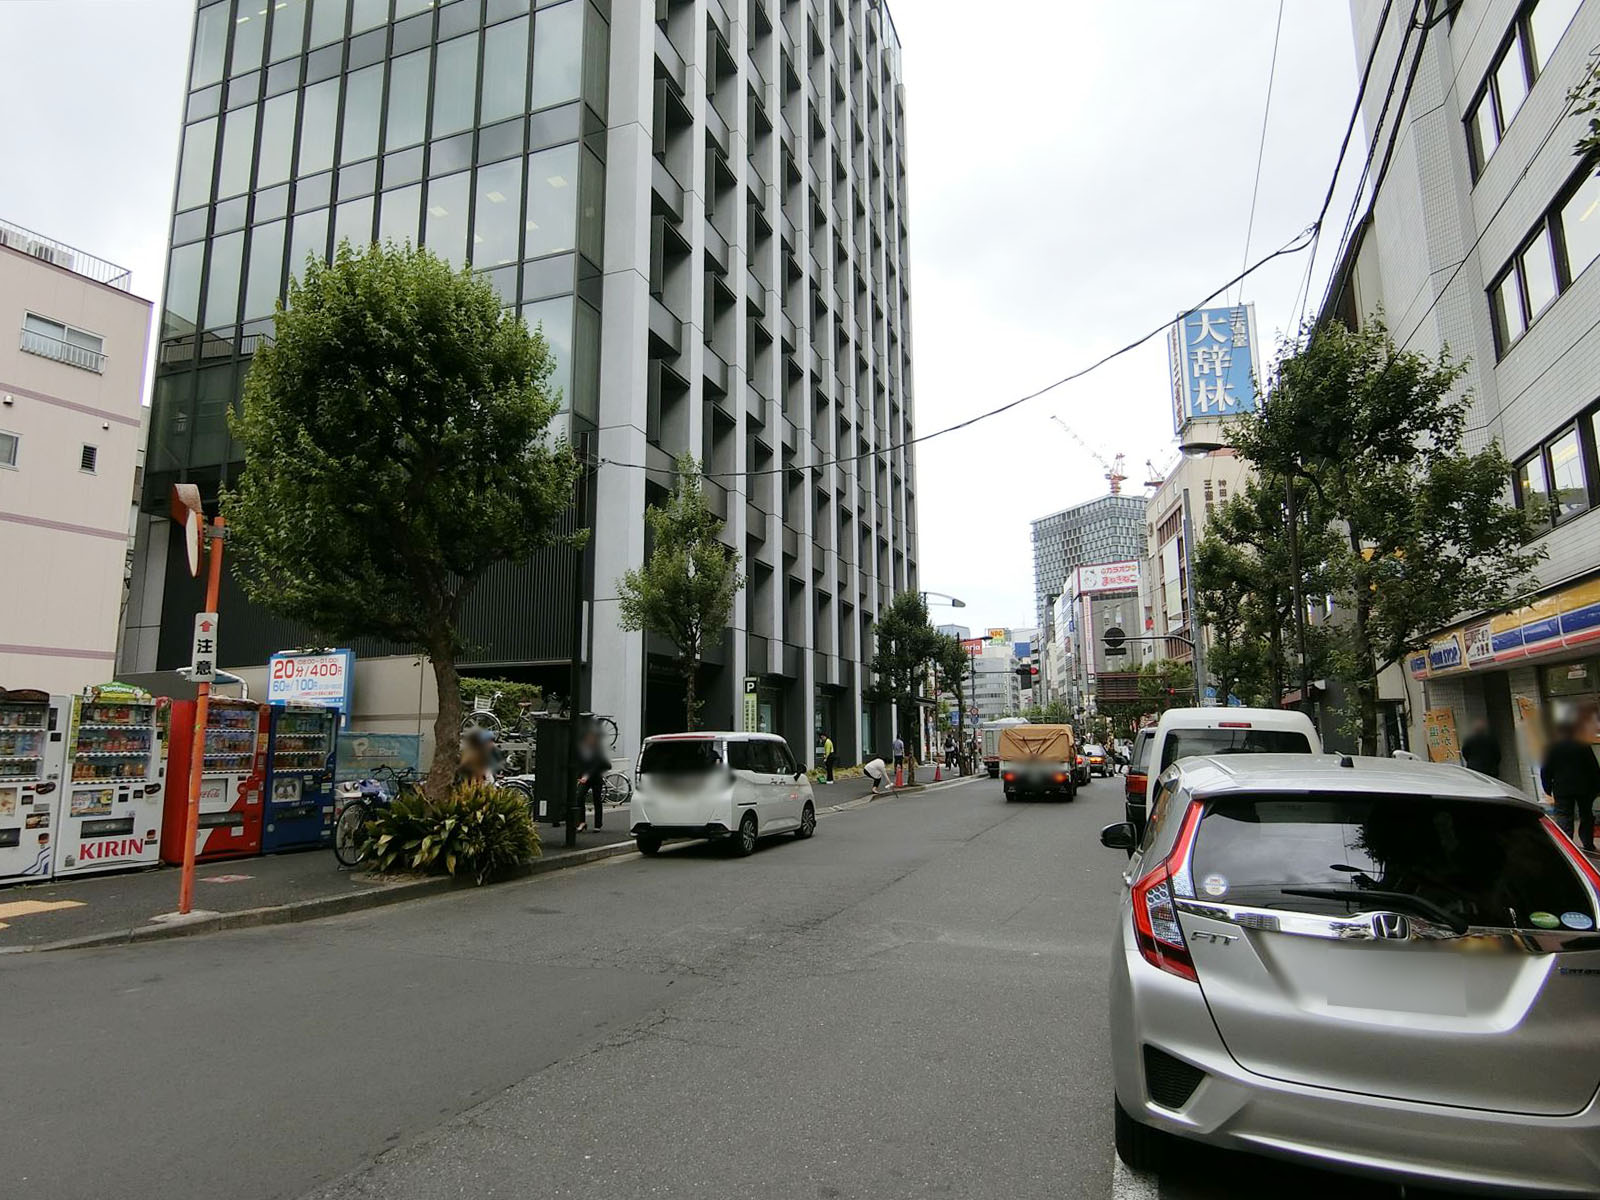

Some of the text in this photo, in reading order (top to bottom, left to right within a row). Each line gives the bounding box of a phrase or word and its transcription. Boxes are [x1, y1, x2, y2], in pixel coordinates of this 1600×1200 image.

[1187, 312, 1236, 413] 大辞林
[196, 638, 213, 676] 注意
[746, 682, 755, 693] P
[79, 838, 144, 860] KIRIN
